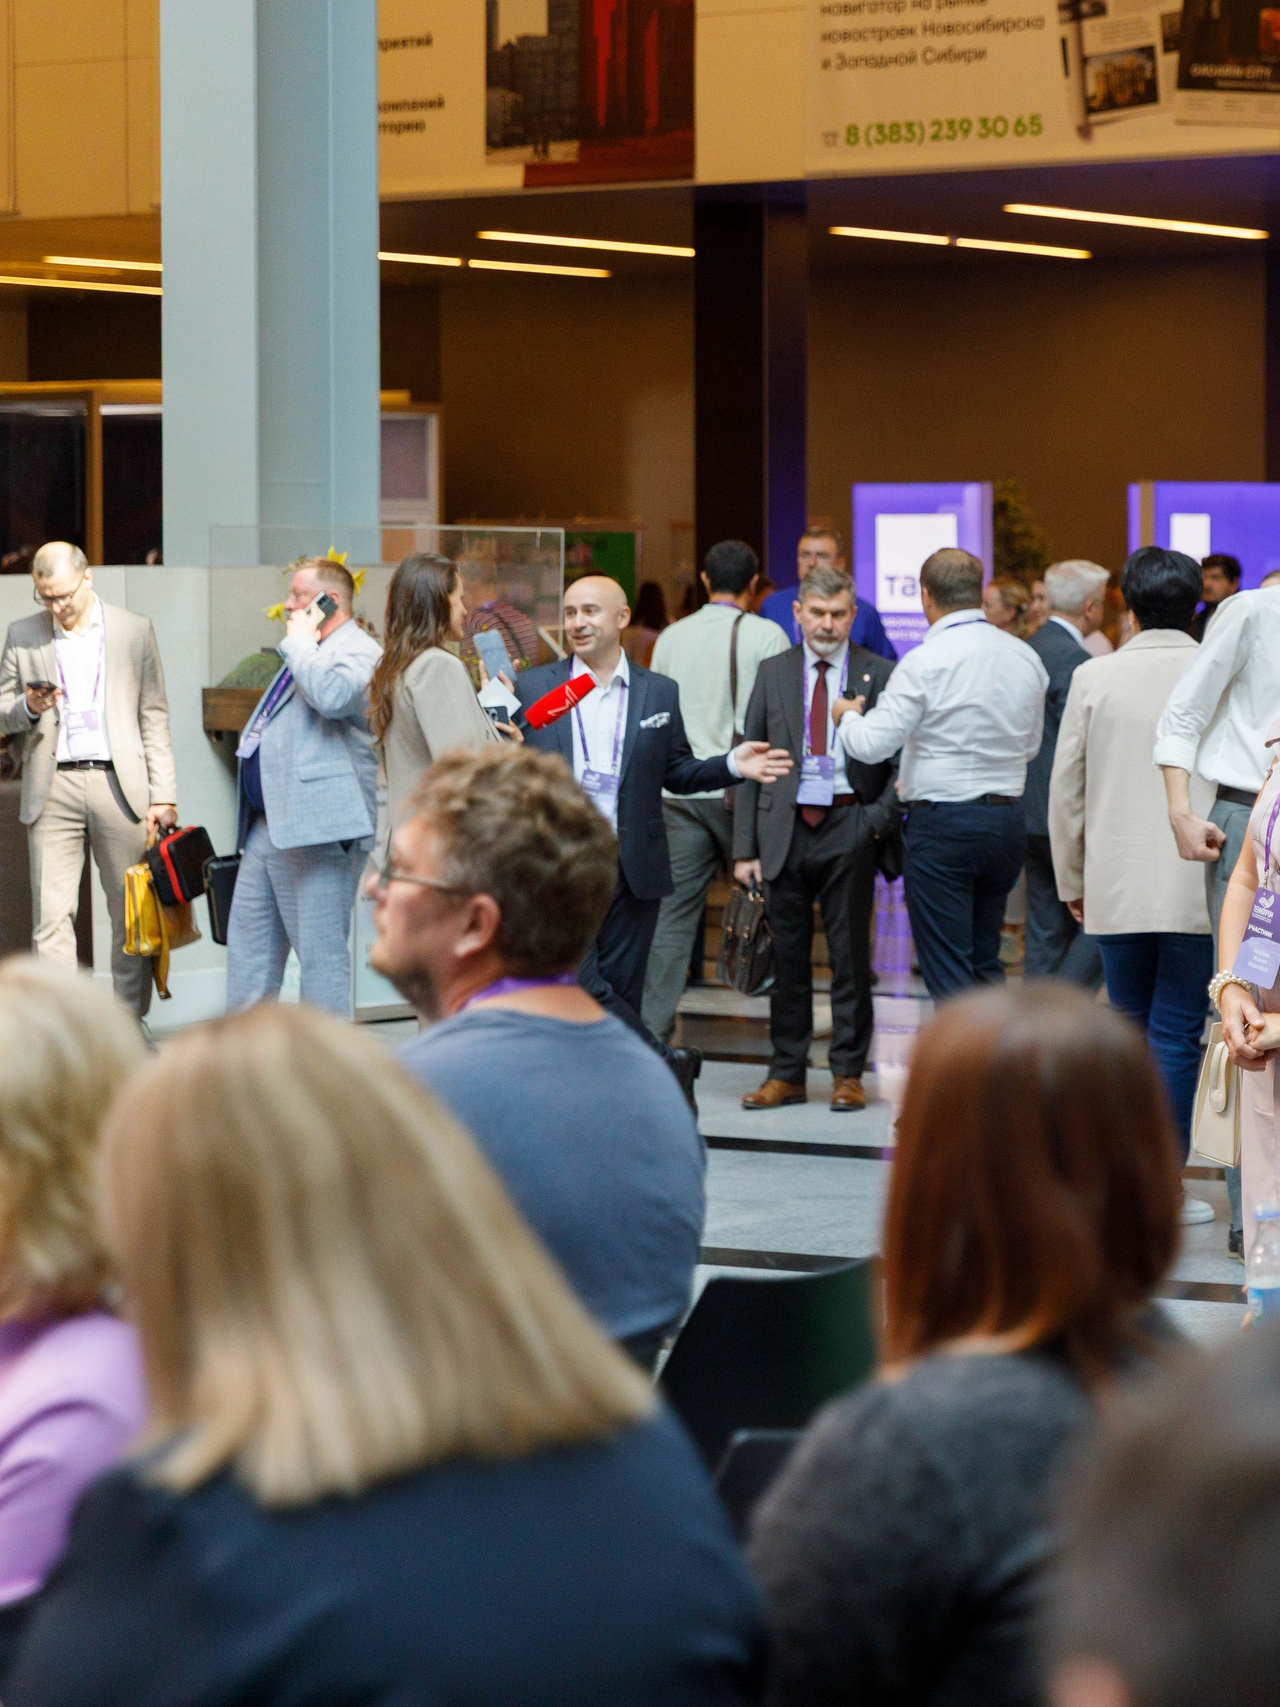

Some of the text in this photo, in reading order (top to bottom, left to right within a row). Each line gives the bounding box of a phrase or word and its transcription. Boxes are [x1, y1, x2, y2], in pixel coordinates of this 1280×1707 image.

[821, 15, 1045, 42] новостроек Новосибирска
[835, 48, 918, 71] Западной
[921, 46, 988, 66] Сибири
[845, 113, 1043, 148] 8 (383) 239 30 65
[885, 575, 917, 597] та
